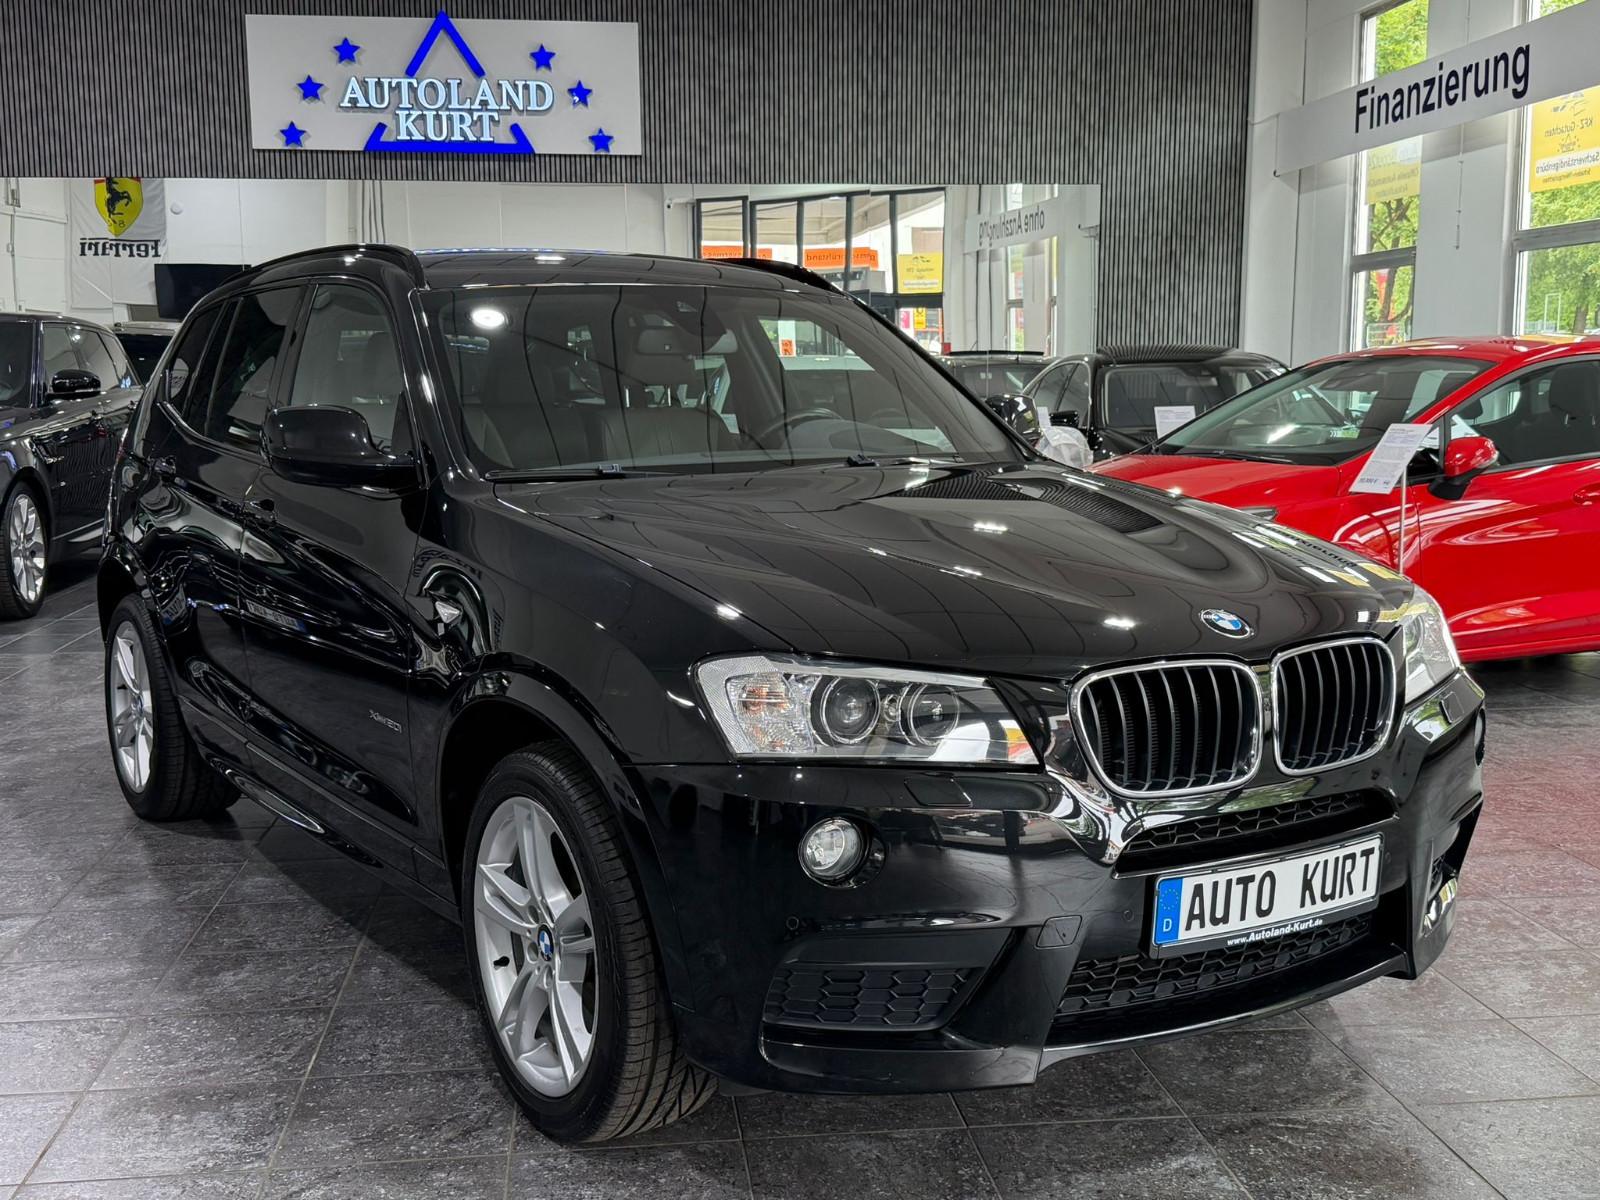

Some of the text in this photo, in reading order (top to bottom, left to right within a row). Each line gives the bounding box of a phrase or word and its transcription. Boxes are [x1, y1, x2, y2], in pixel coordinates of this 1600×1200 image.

[340, 76, 555, 112] AUTOLAND
[1355, 44, 1531, 133] Finanzierung
[395, 110, 499, 142] KURT
[1185, 846, 1375, 932] AUTO KURT
[1162, 918, 1173, 932] D
[1227, 918, 1323, 946] www.Autoland-Kurt.de
